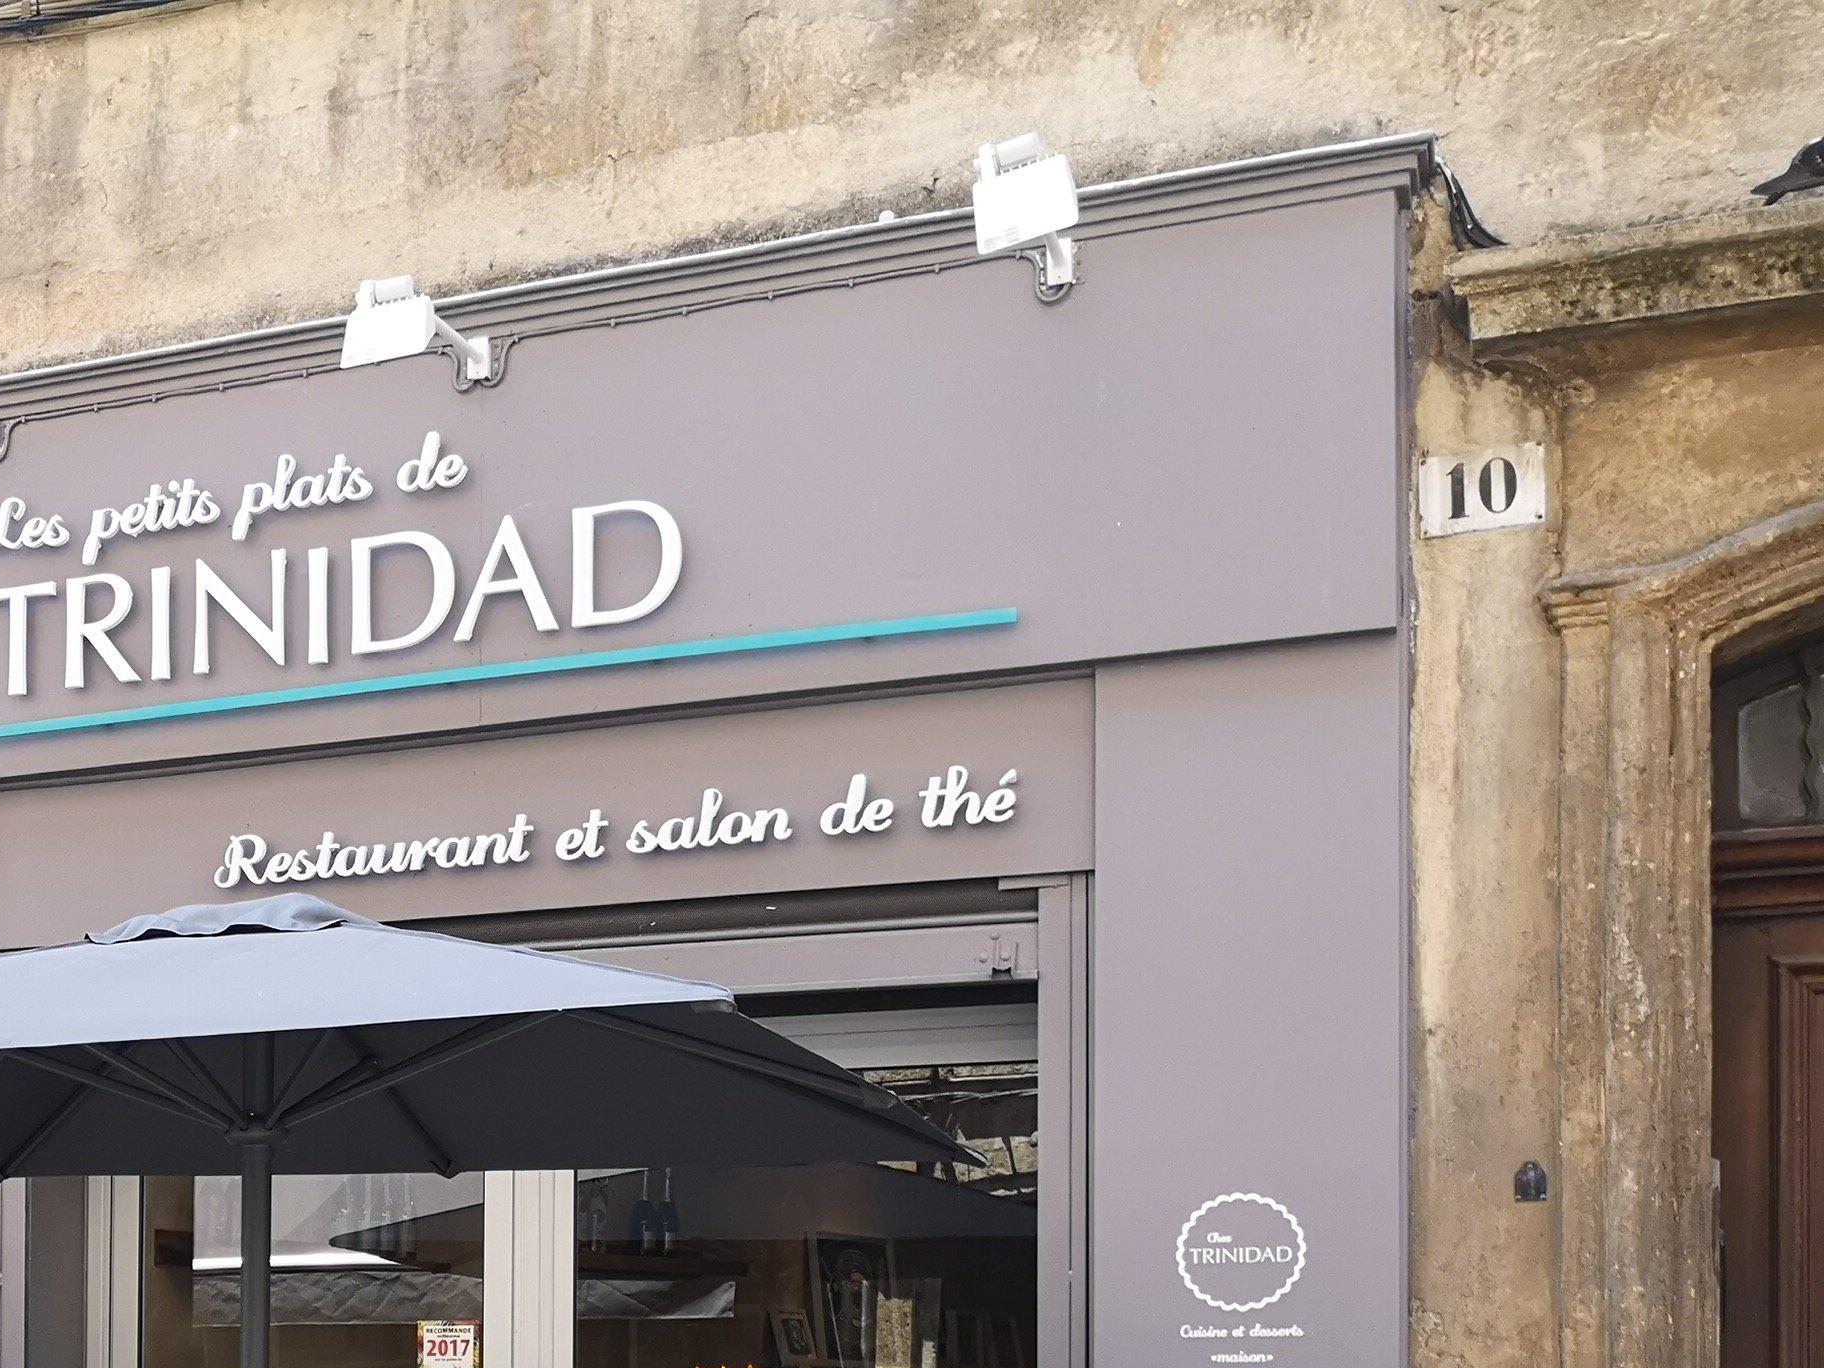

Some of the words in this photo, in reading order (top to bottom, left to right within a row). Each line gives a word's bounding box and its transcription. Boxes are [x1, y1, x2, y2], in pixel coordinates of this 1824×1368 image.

[81, 478, 221, 566] petits
[232, 453, 372, 541] plats
[396, 431, 469, 492] de
[1446, 457, 1518, 520] 10
[214, 814, 534, 888] Restaurant
[554, 808, 610, 861] et
[626, 788, 792, 853] salon
[820, 773, 894, 834] de
[919, 765, 1017, 827] thé
[1189, 1245, 1293, 1265] TRINIDAD
[426, 1339, 471, 1357] 2017
[1179, 1324, 1229, 1339] Cuisine
[1231, 1324, 1246, 1338] et
[1248, 1322, 1305, 1338] desserts
